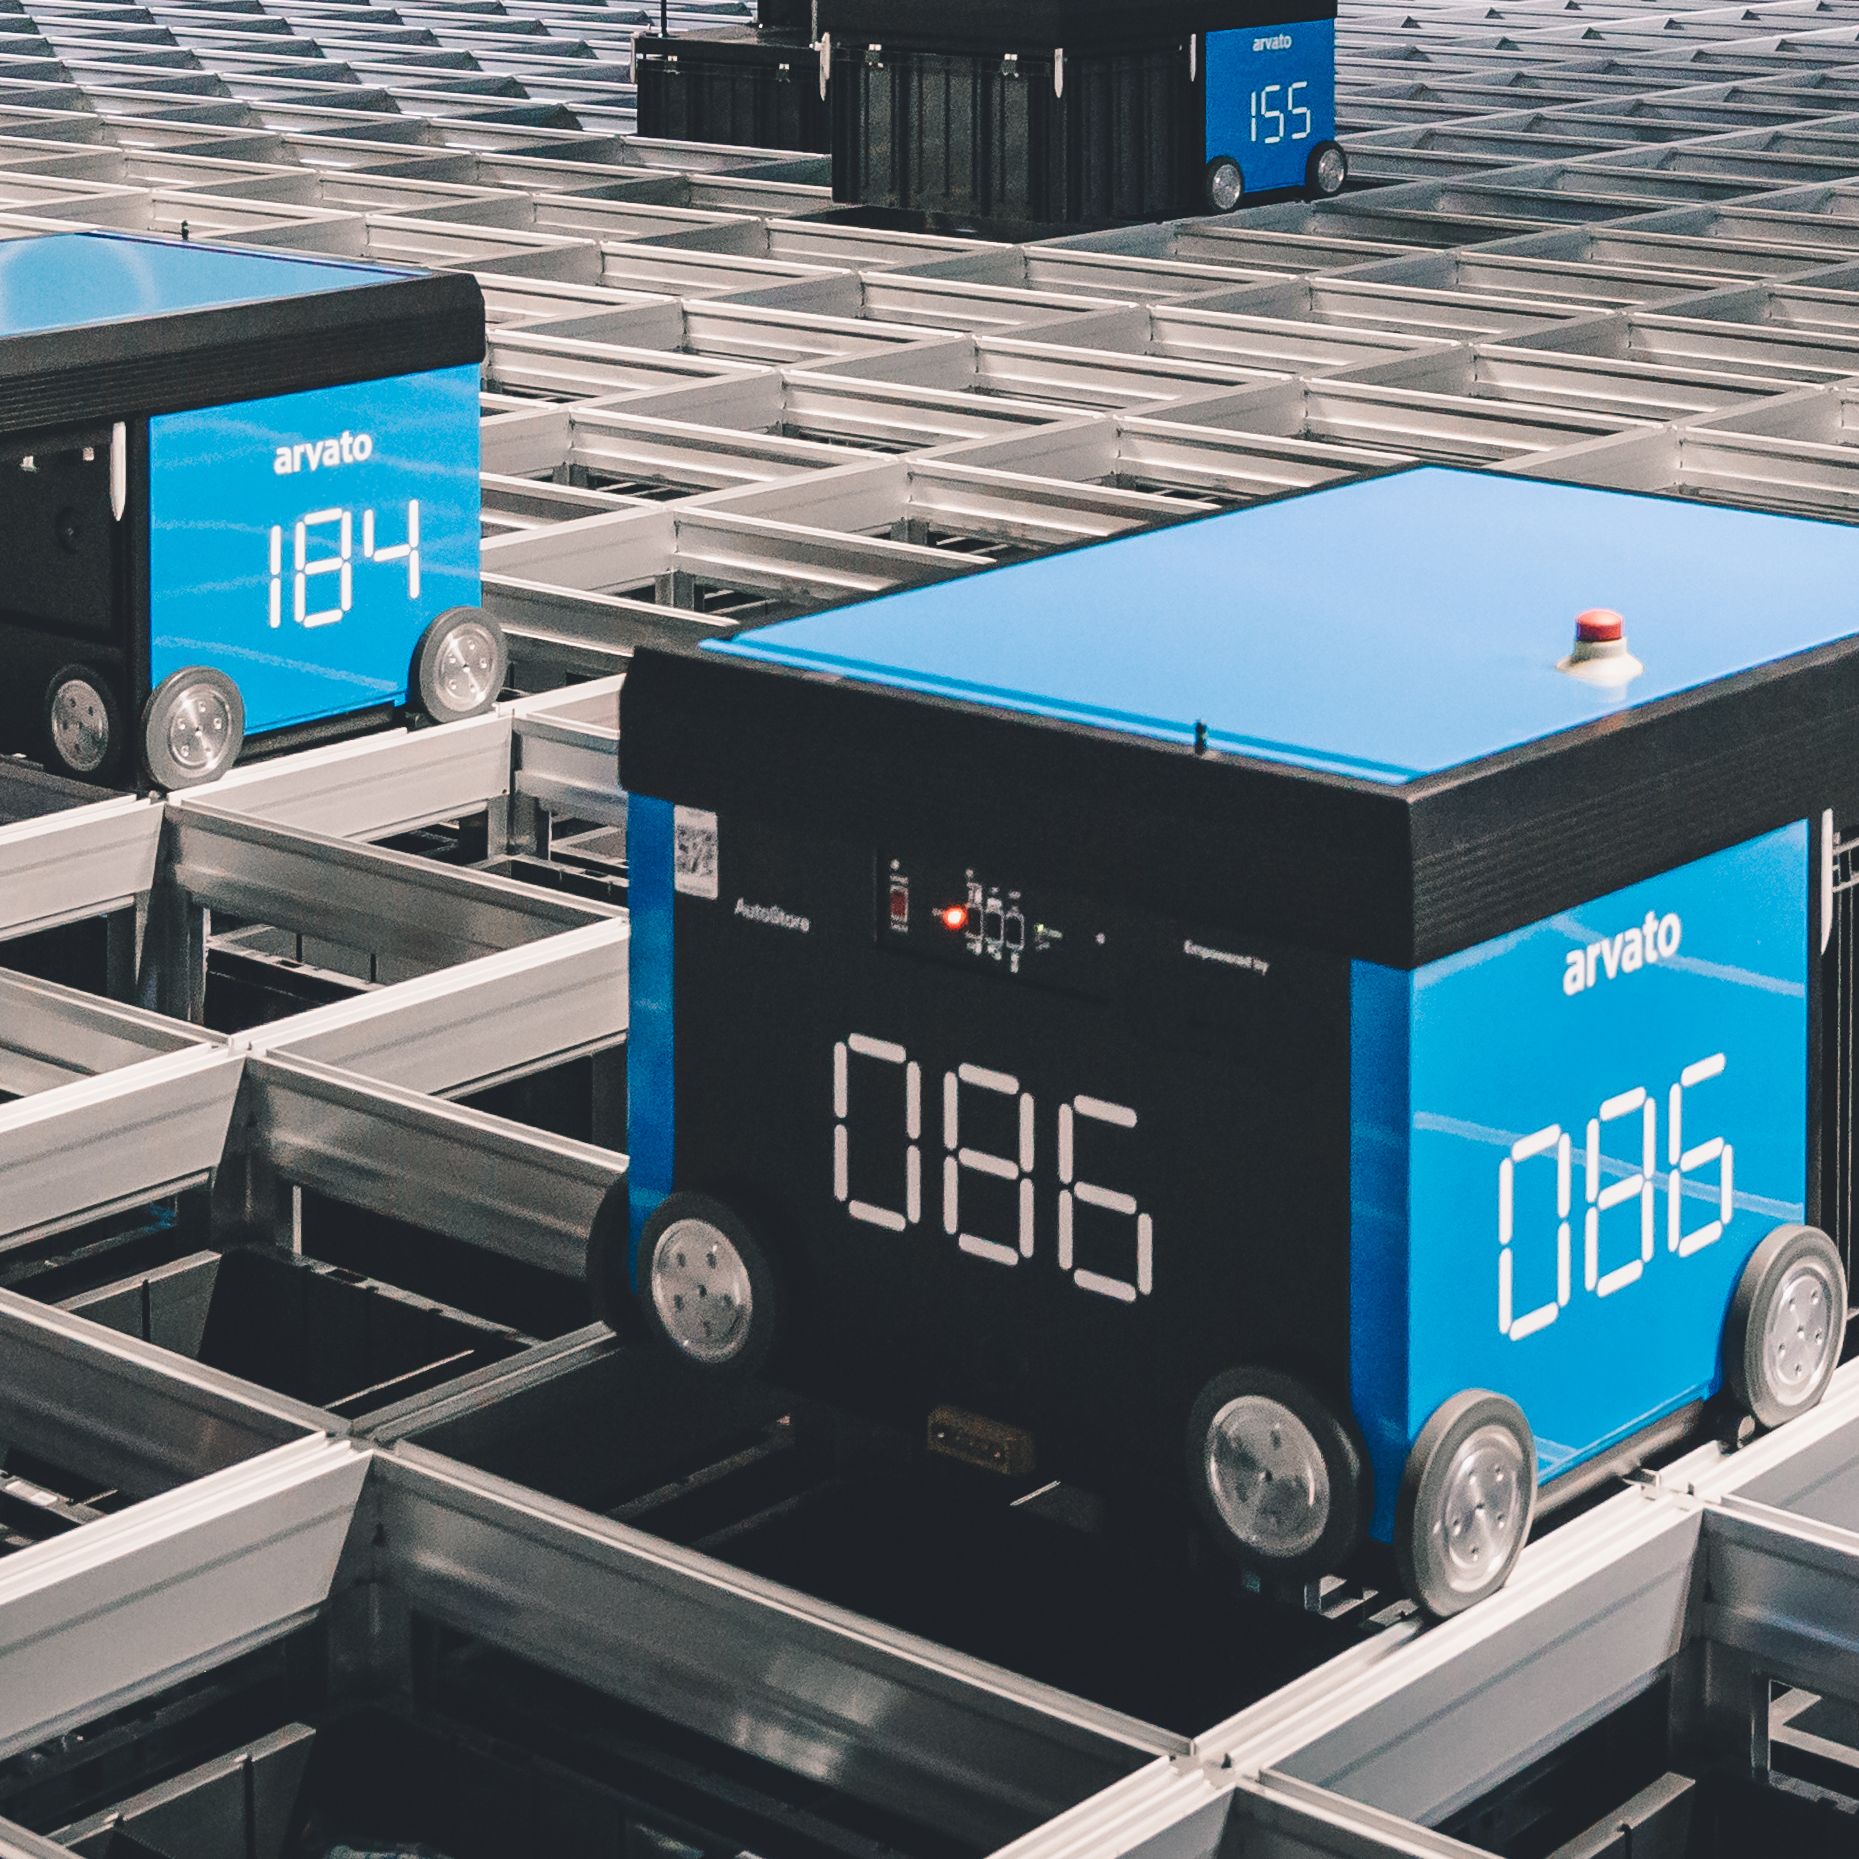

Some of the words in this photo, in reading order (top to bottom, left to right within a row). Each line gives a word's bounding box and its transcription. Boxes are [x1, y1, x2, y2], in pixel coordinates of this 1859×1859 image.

[1252, 33, 1292, 52] arvato
[1250, 81, 1311, 144] 155
[274, 432, 373, 475] arvato
[269, 498, 420, 629] 184
[1563, 910, 1682, 996] arvato
[834, 1033, 1153, 1303] 086
[1498, 1052, 1733, 1342] 086
